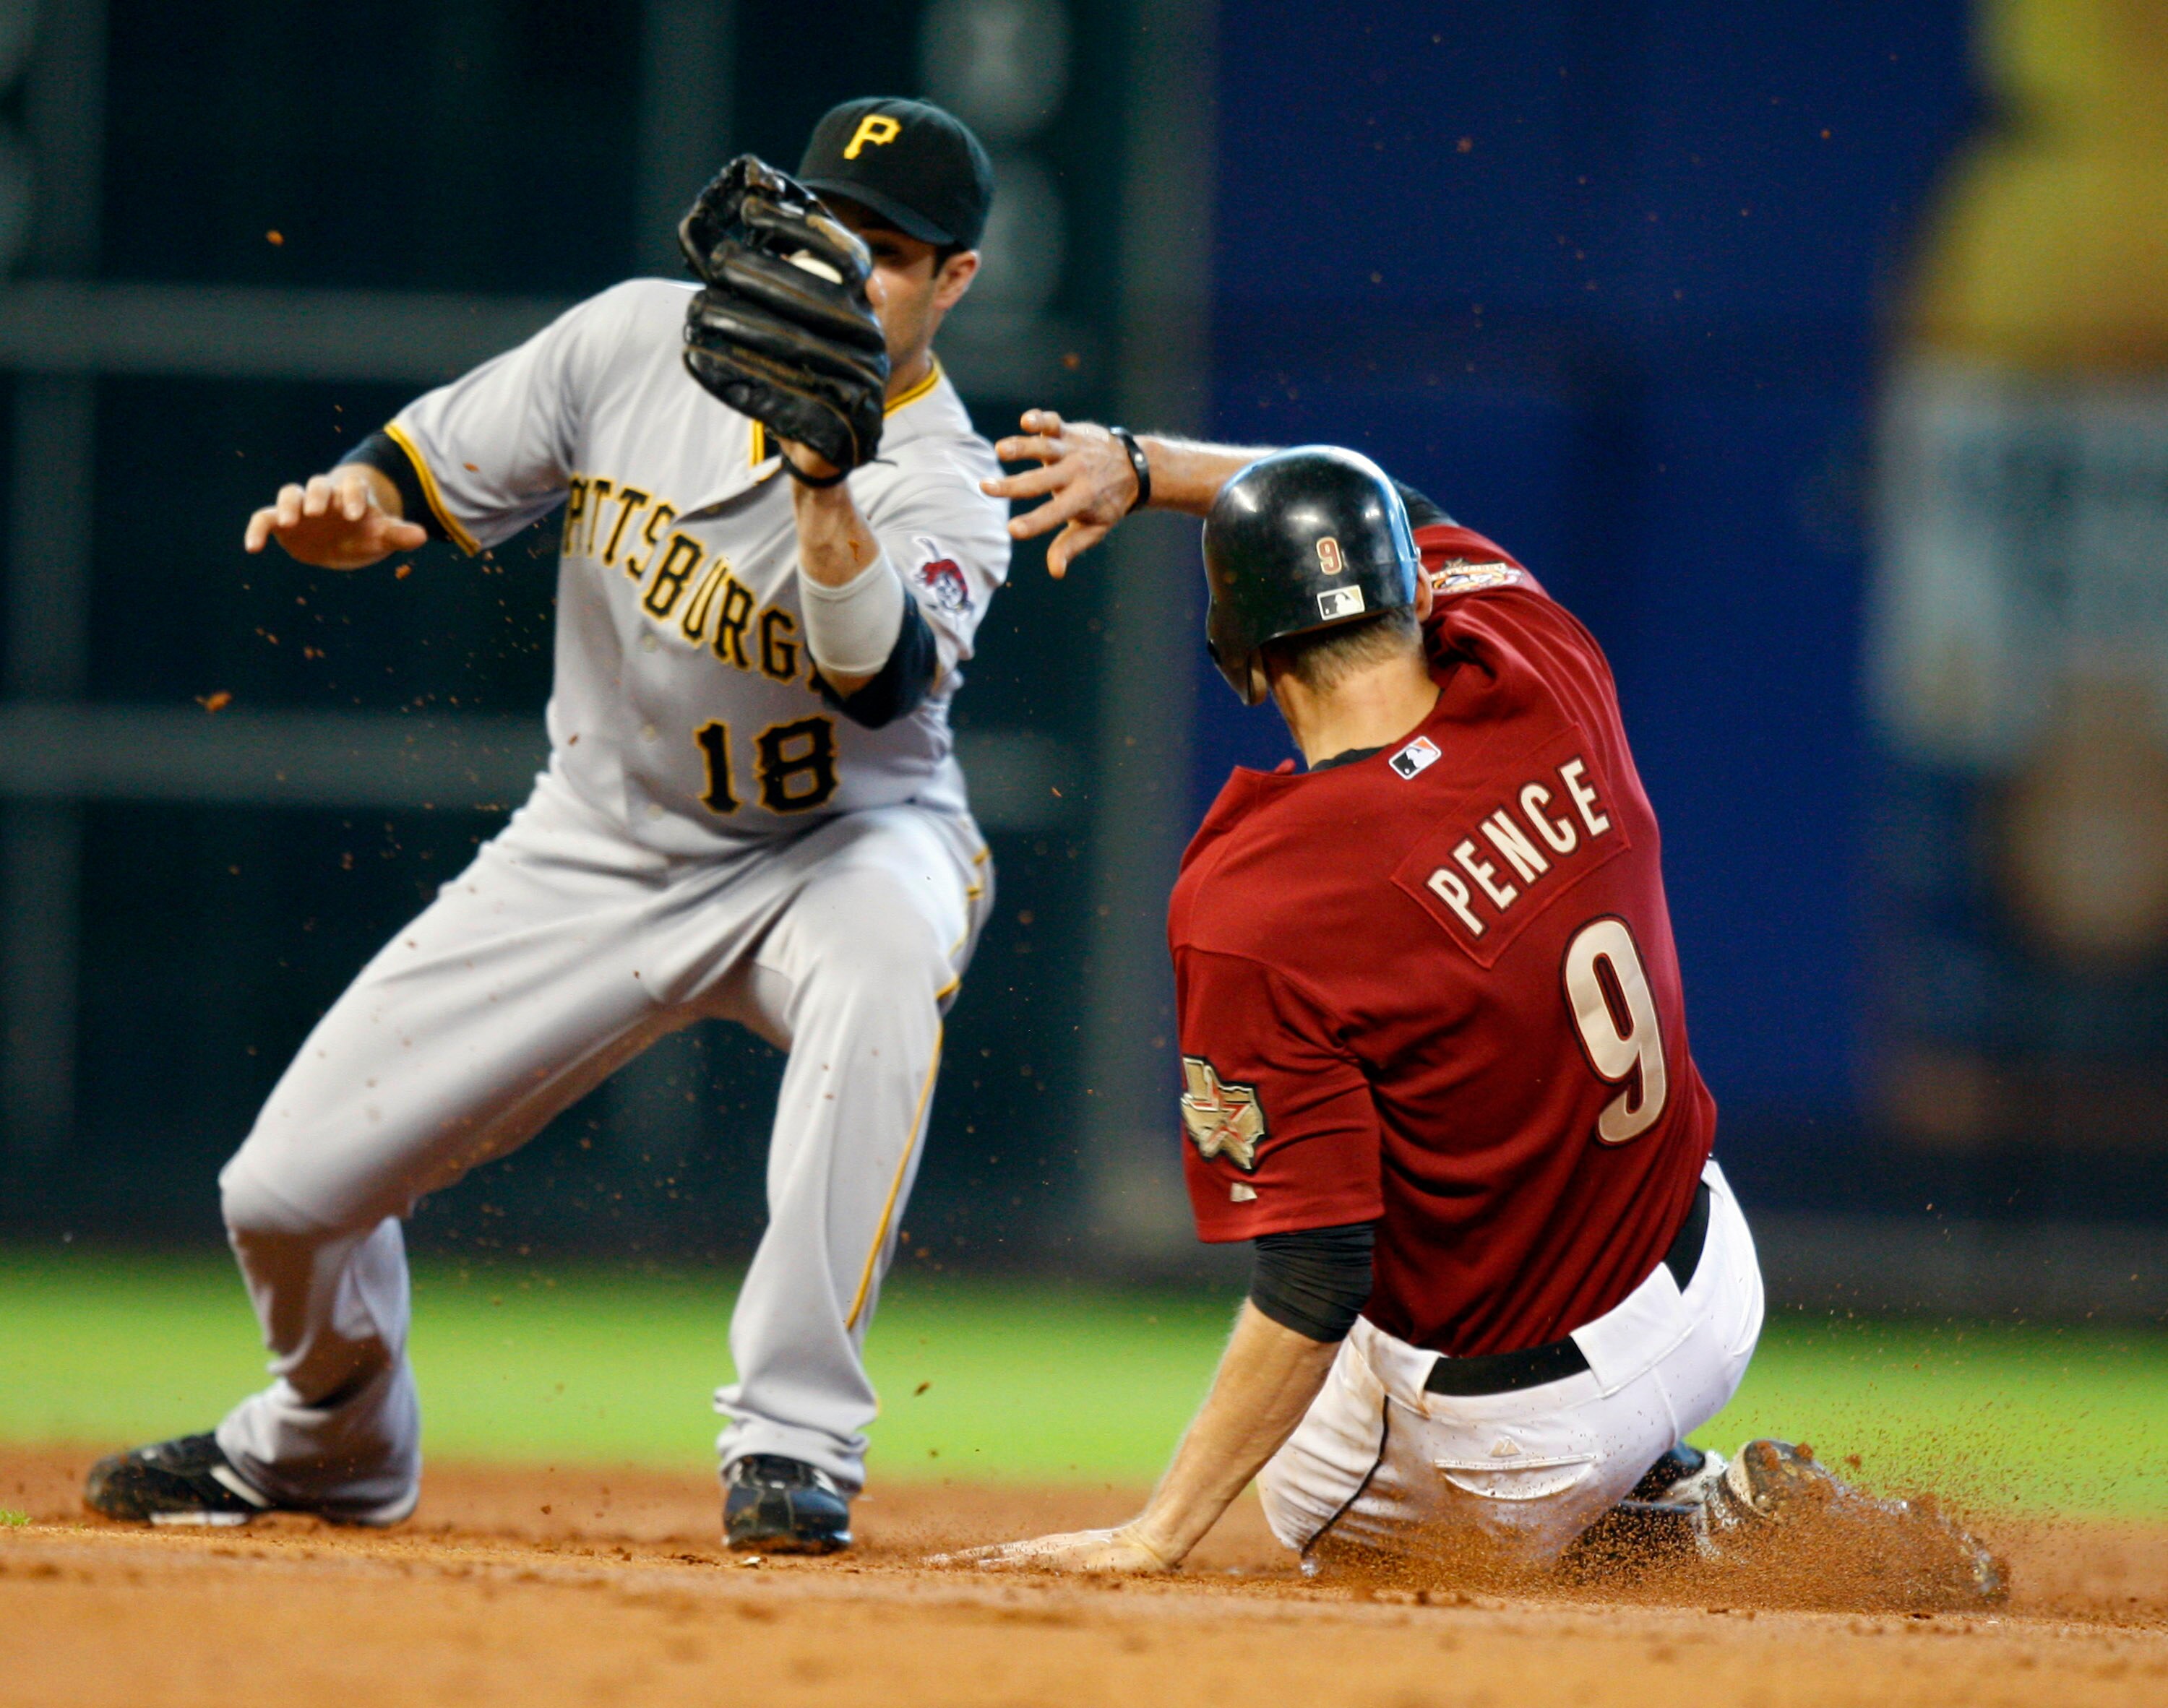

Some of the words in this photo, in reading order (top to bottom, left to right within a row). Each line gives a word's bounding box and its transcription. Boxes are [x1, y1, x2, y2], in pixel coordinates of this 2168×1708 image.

[843, 114, 902, 160] P
[562, 473, 822, 694] PTTSBURG
[1316, 536, 1342, 575] 9
[692, 713, 840, 816] 18
[1426, 754, 1612, 939] PENCE
[1559, 913, 1669, 1148] 9
